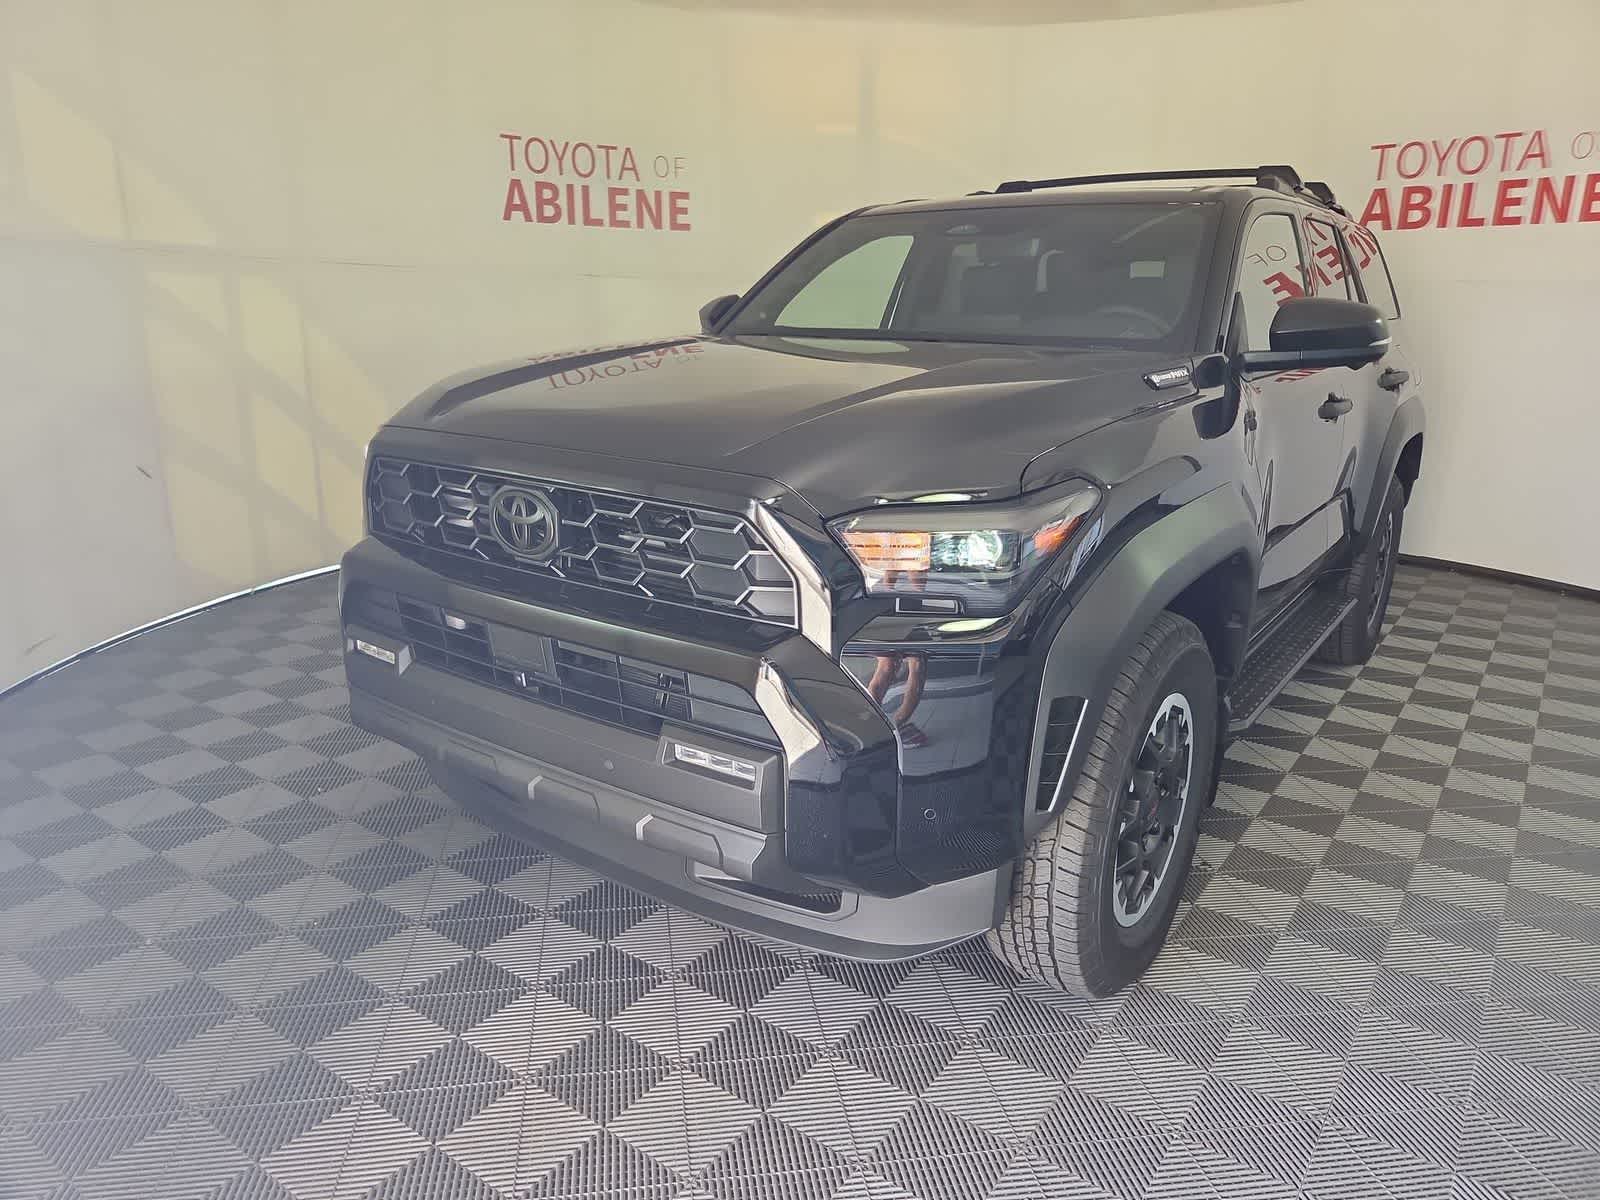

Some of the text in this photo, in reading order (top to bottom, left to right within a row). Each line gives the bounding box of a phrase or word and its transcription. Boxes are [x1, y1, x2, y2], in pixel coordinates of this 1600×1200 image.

[500, 133, 686, 182] TOYOTA OF
[1371, 130, 1600, 180] TOYOTA O
[503, 178, 691, 231] ABILENE
[1358, 173, 1600, 230] ABILENE
